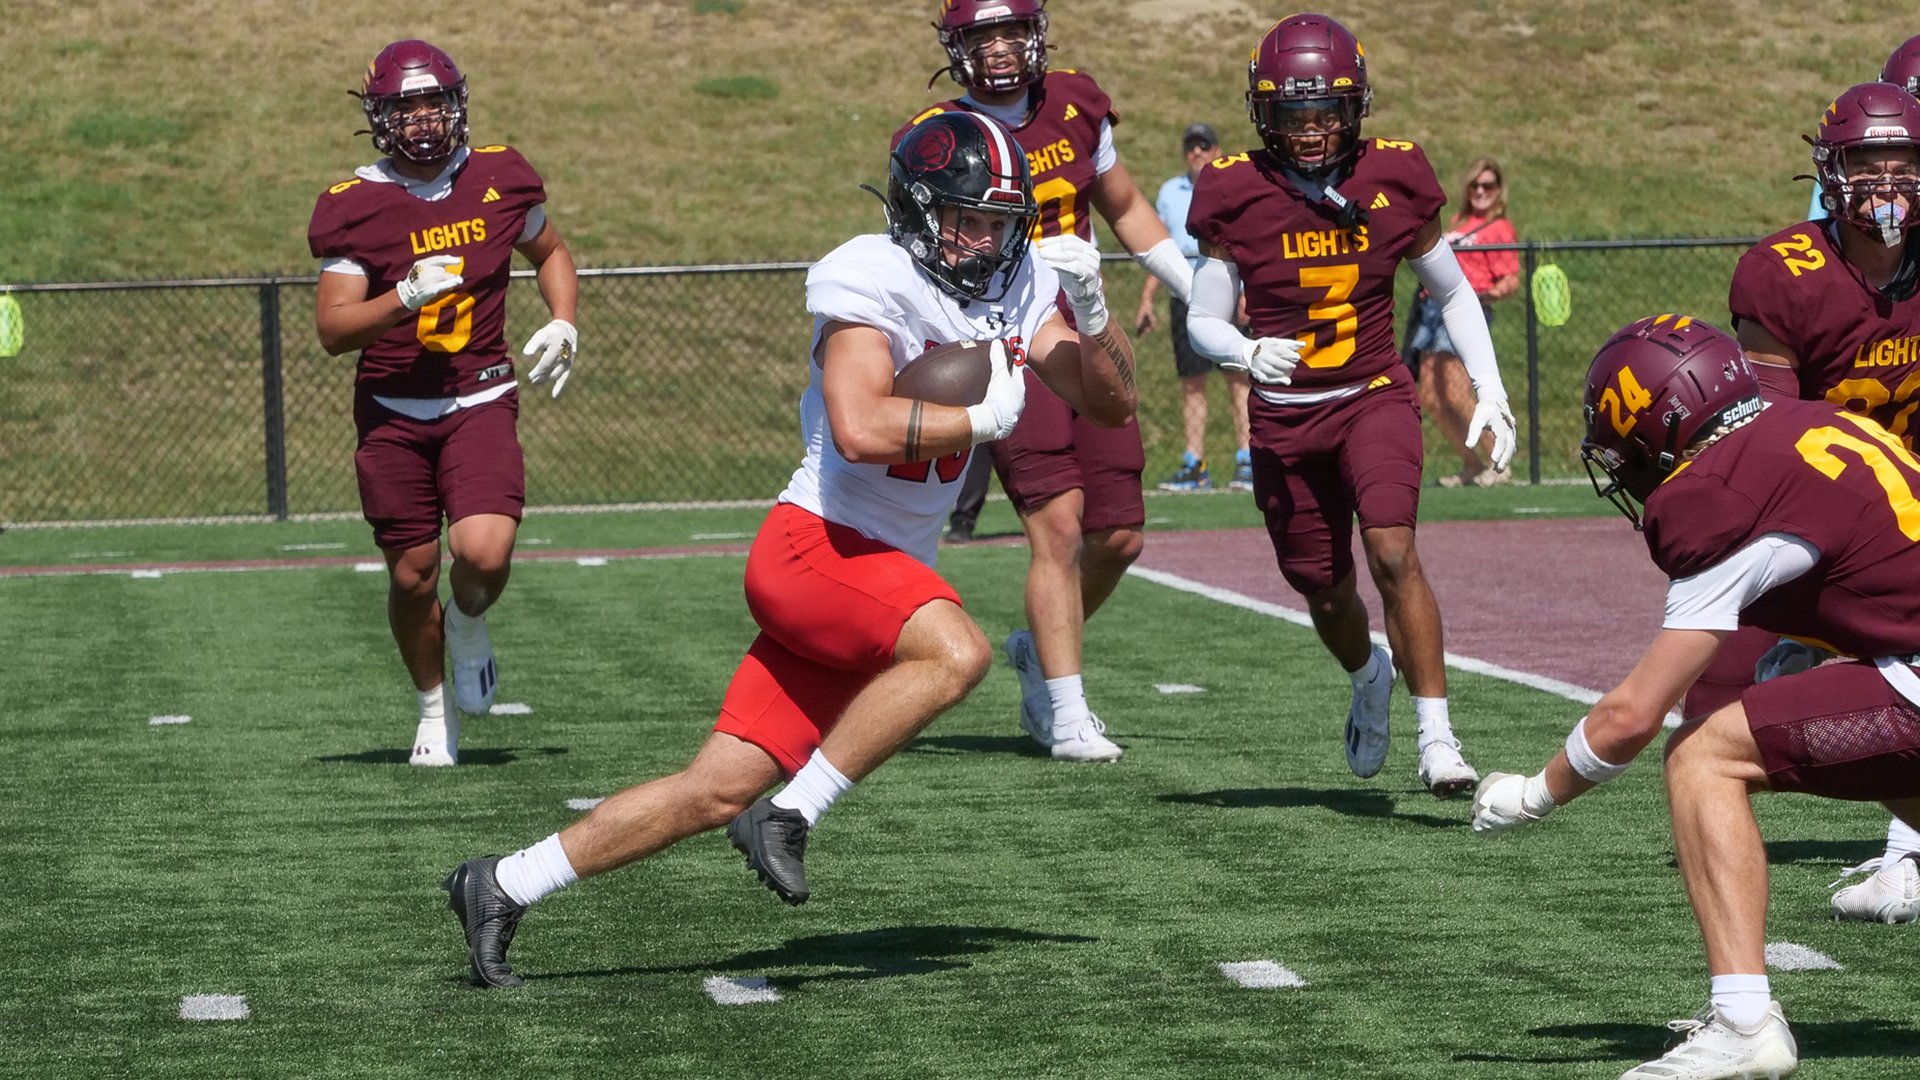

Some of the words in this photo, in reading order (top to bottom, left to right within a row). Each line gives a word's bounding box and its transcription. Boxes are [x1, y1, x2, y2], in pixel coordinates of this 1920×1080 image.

[1025, 138, 1075, 177] GHTS
[410, 218, 486, 255] LIGHTS
[1282, 225, 1369, 259] LIGHTS
[1771, 233, 1826, 277] 22
[1296, 263, 1360, 369] 3
[1855, 335, 1920, 368] LIGHT
[1600, 365, 1652, 438] 24
